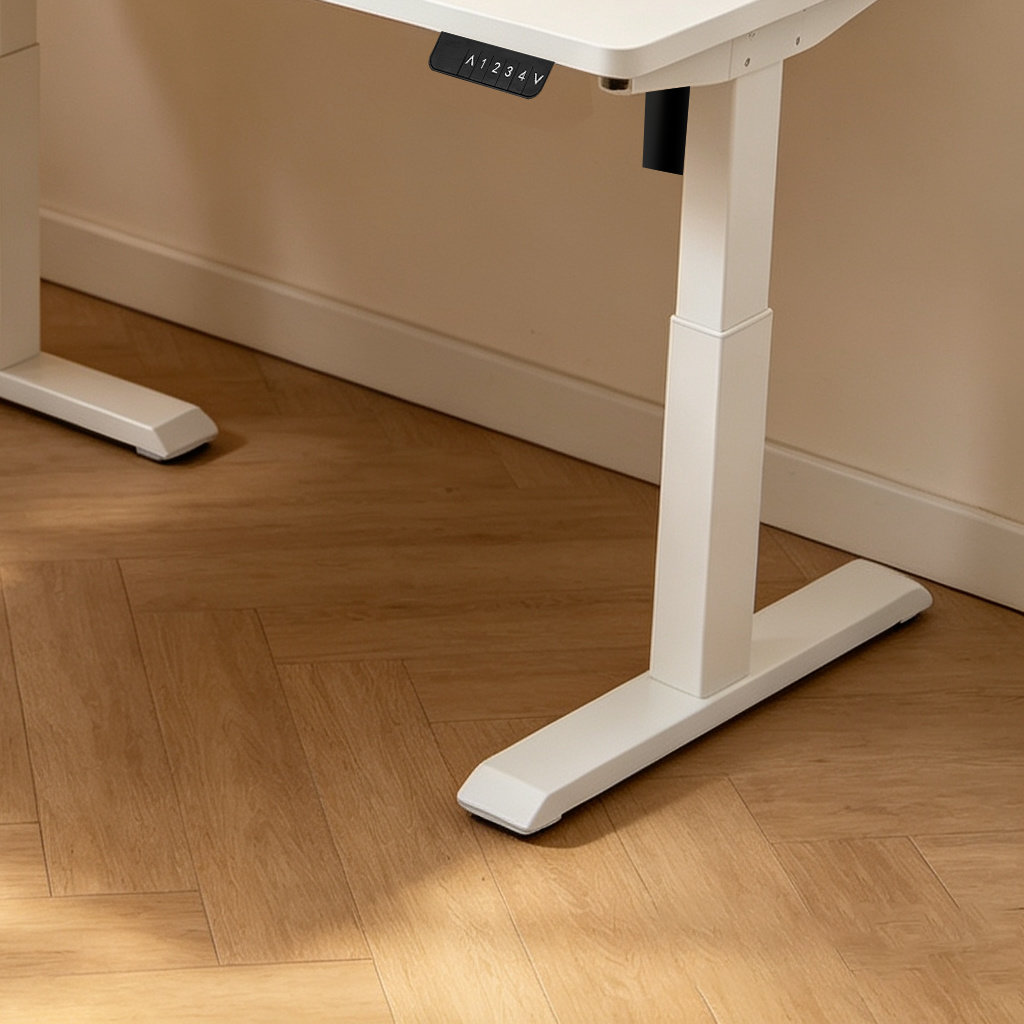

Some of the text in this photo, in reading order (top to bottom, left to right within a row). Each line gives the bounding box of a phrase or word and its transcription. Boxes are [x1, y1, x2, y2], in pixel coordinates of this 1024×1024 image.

[480, 58, 527, 82] 1 2 3 4
